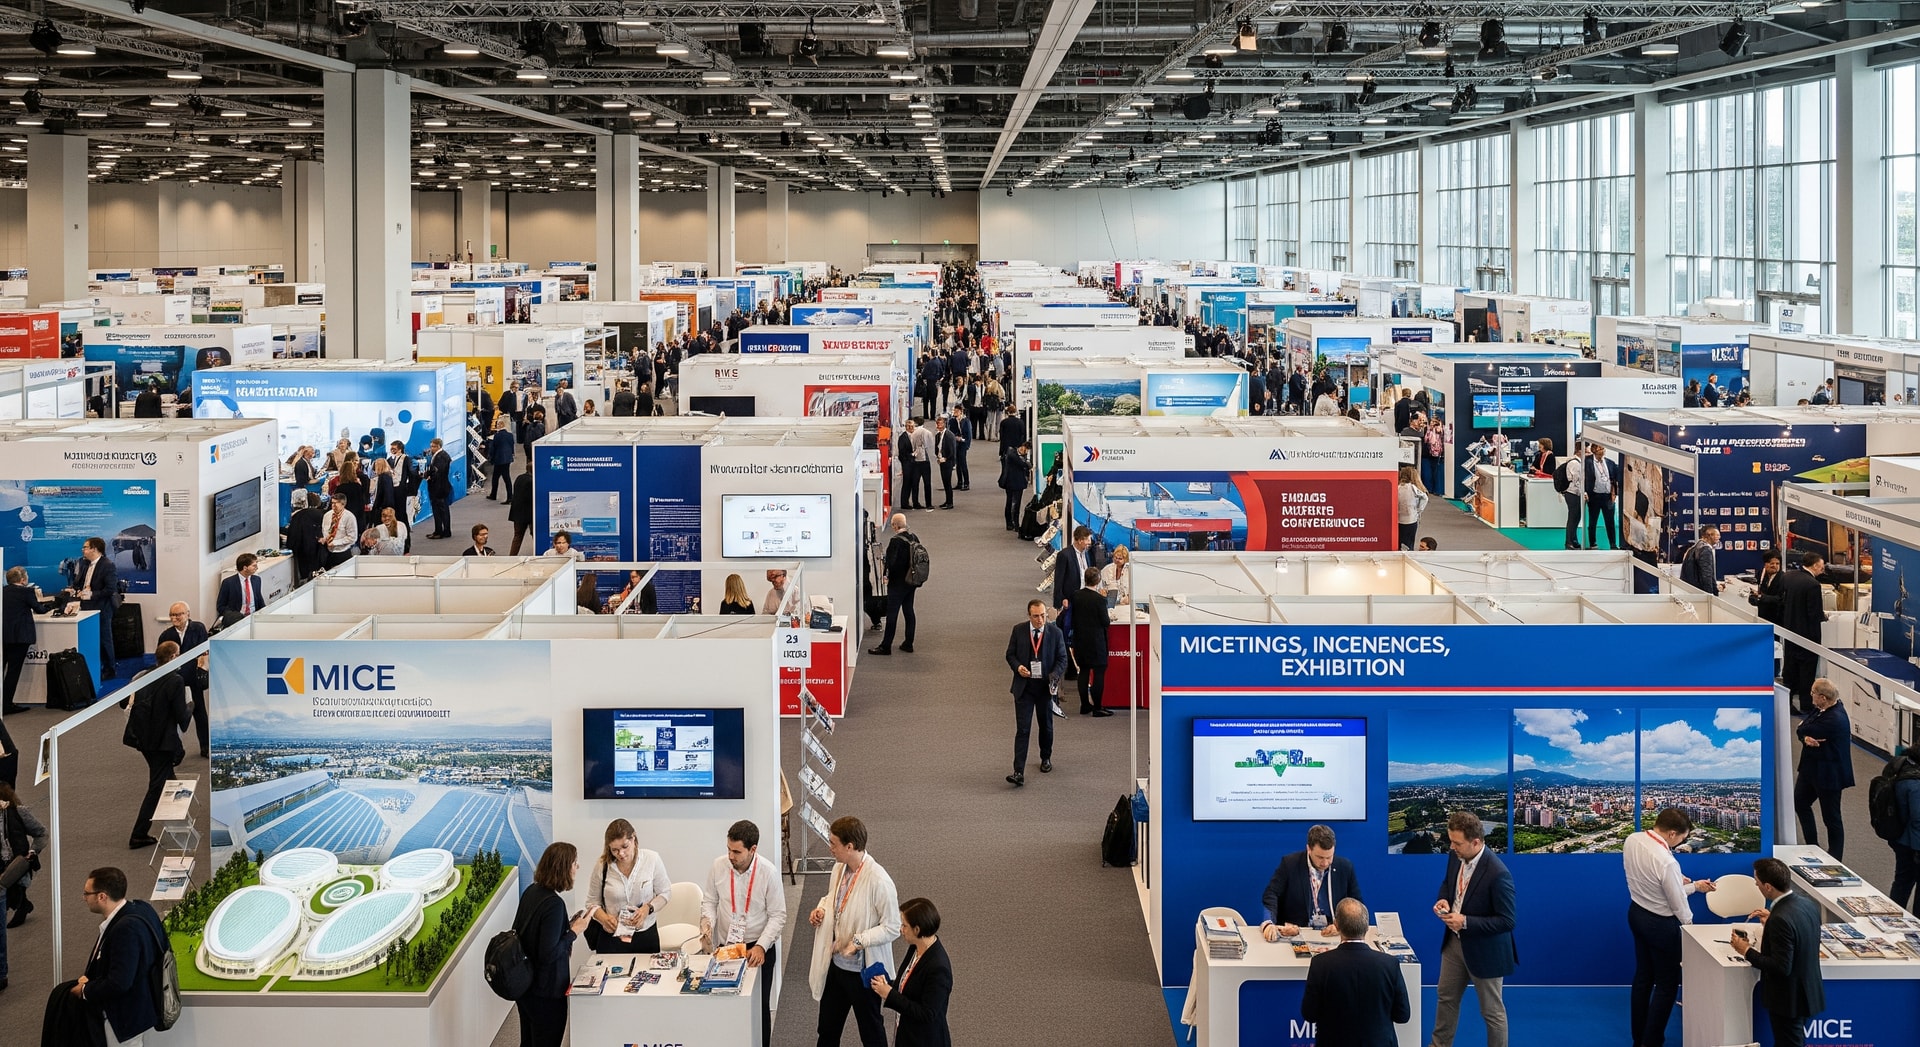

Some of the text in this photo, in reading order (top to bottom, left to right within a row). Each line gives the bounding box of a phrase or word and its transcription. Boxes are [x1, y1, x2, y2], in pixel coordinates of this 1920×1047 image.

[1180, 635, 1451, 657] MICETINGS, INCENENCES,
[312, 664, 396, 691] MICE
[1281, 658, 1406, 677] EXHIBITION
